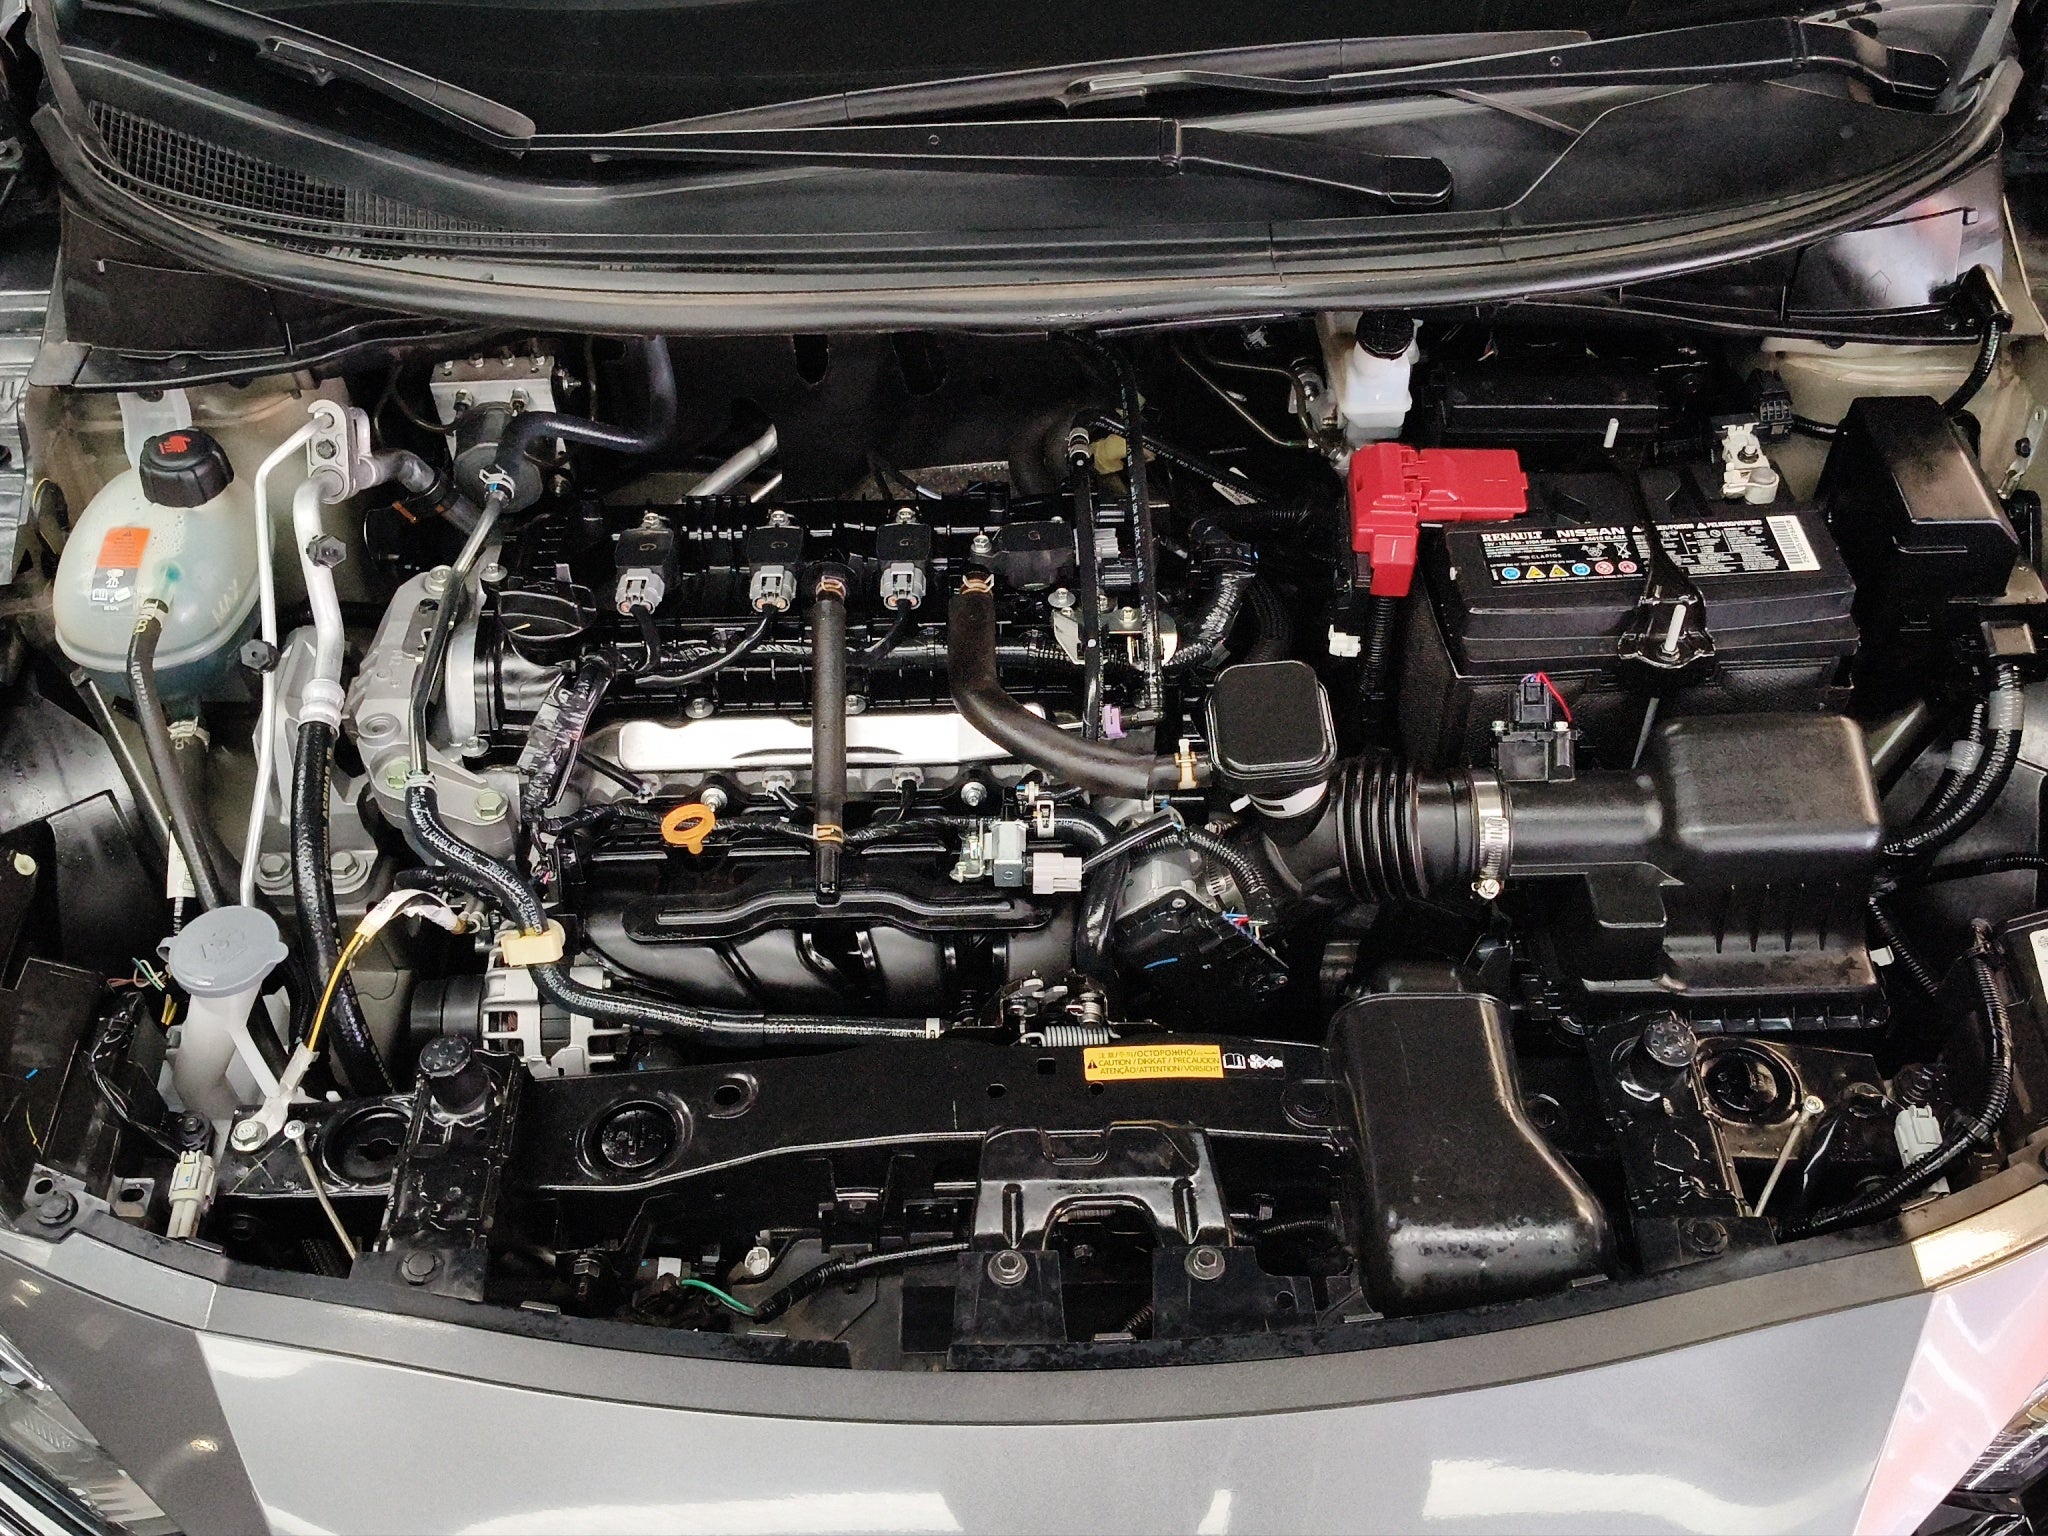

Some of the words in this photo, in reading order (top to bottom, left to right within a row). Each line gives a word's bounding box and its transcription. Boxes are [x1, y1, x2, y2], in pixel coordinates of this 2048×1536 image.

[1481, 531, 1543, 543] RENAULT
[1556, 526, 1626, 538] NISSAN
[1531, 552, 1563, 560] CLARIOS
[1098, 1057, 1132, 1066] CAUTION
